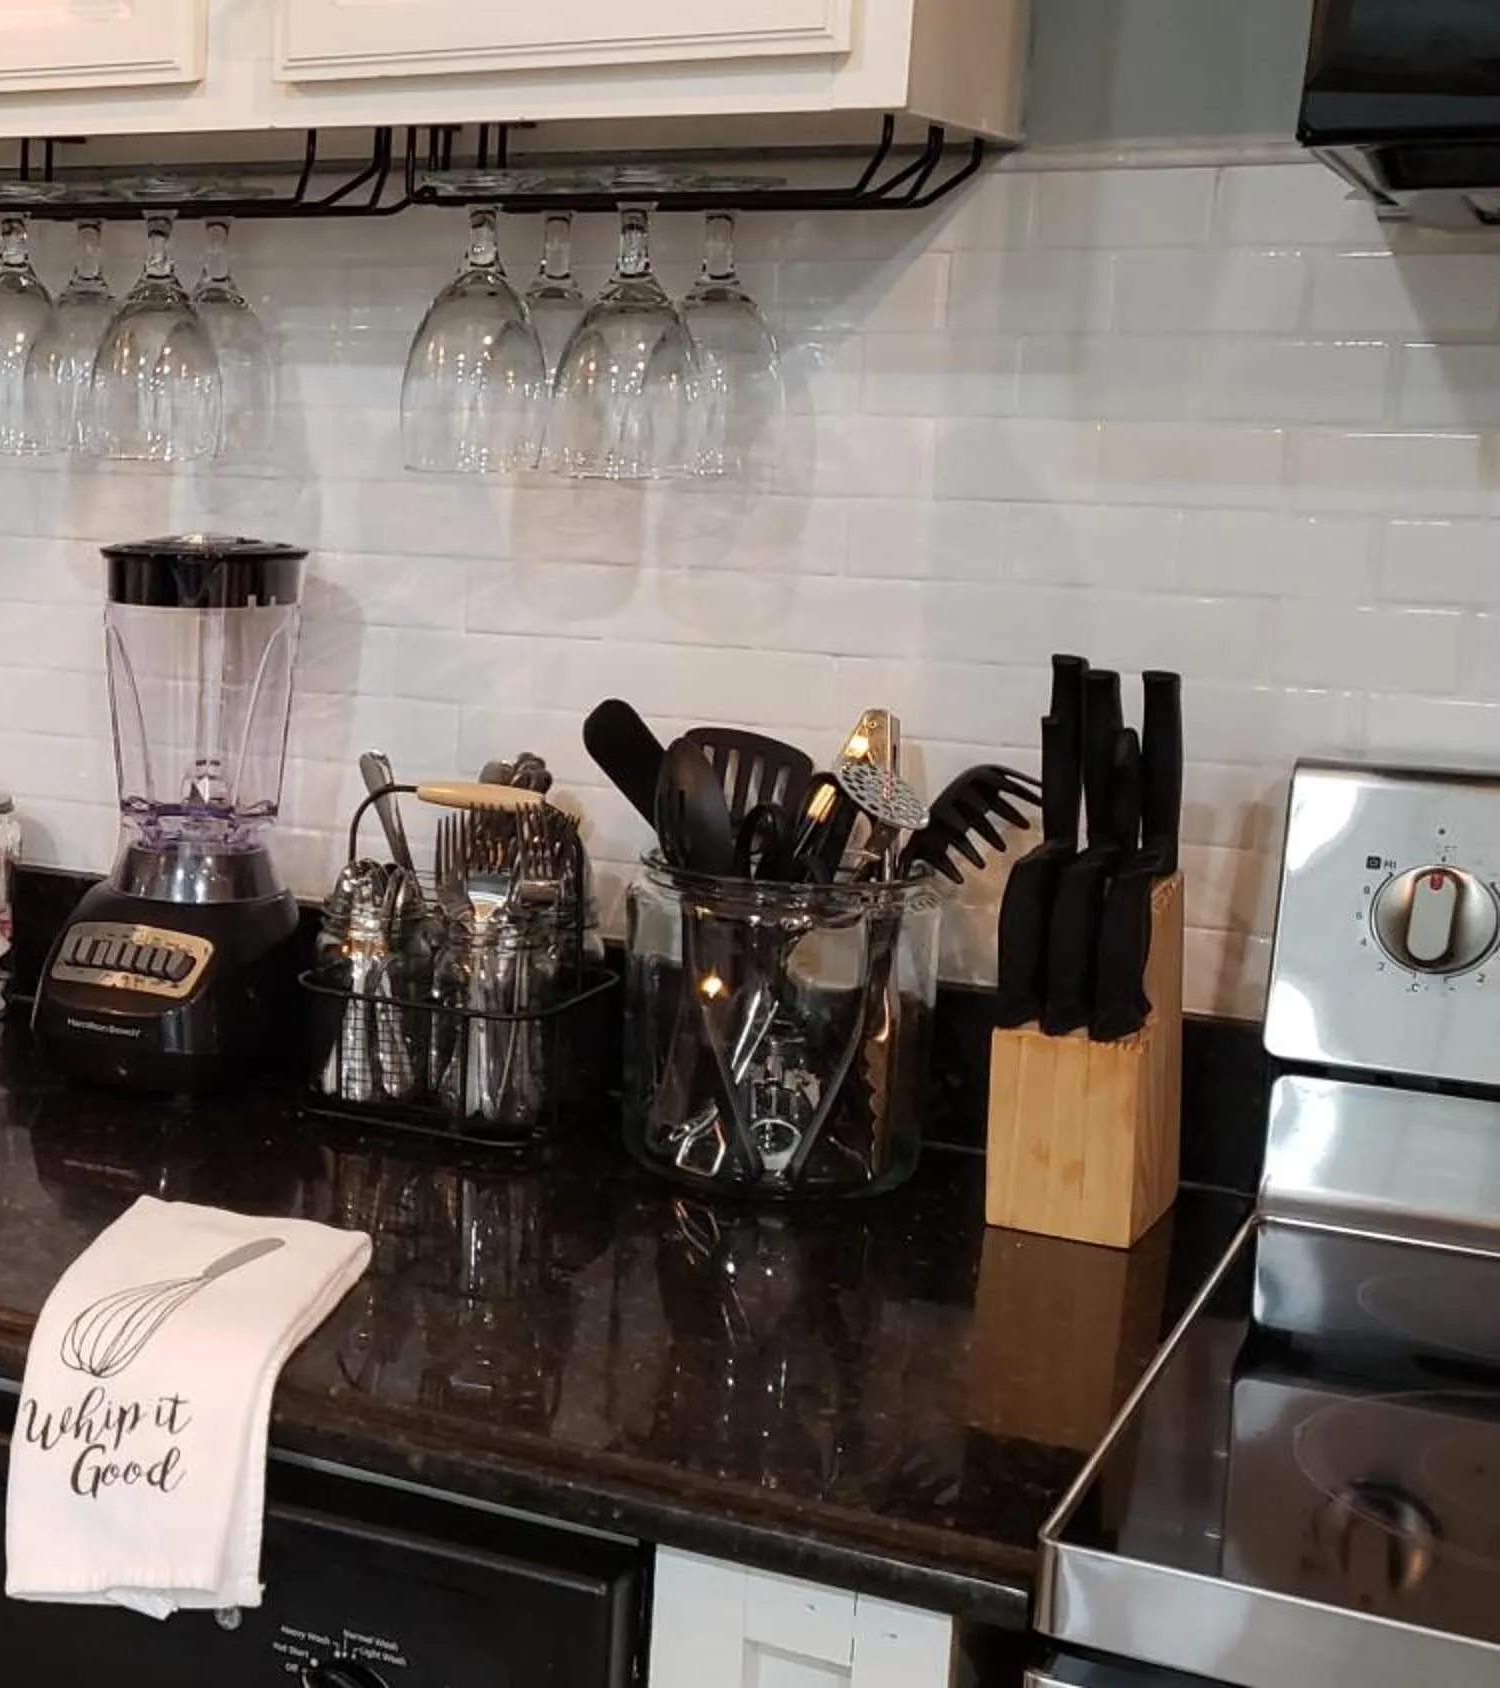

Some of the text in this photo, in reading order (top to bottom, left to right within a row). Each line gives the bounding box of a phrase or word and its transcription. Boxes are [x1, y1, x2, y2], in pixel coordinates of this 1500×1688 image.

[23, 1385, 192, 1451] Whip it
[70, 1444, 187, 1499] Good
